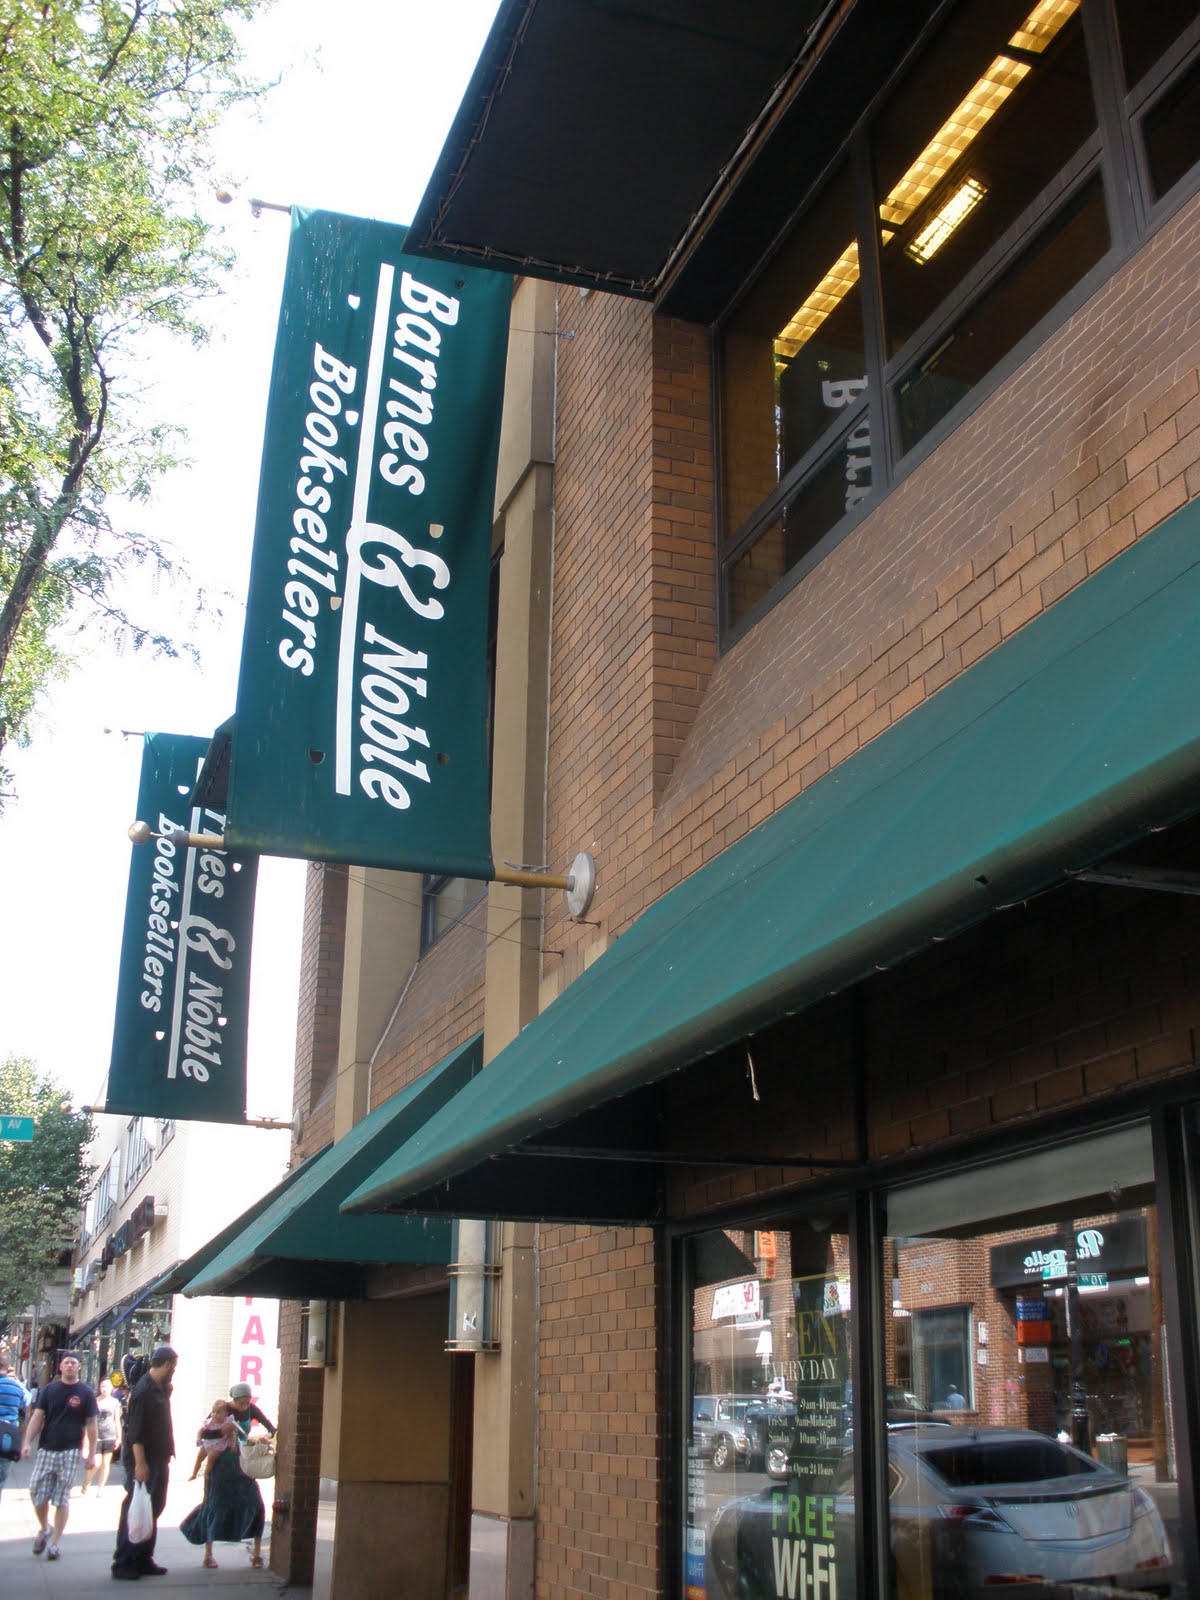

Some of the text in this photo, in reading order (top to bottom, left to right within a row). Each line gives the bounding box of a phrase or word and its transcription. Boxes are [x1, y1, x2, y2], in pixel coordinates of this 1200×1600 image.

[279, 341, 357, 676] Booksellers
[346, 271, 460, 810] Barnes & Noble
[141, 812, 185, 1013] Booksellers
[179, 914, 236, 970] &
[182, 971, 223, 1083] Noble
[7, 1118, 23, 1129] AV
[772, 1492, 835, 1539] FREE
[772, 1536, 837, 1600] Wi-Fi
